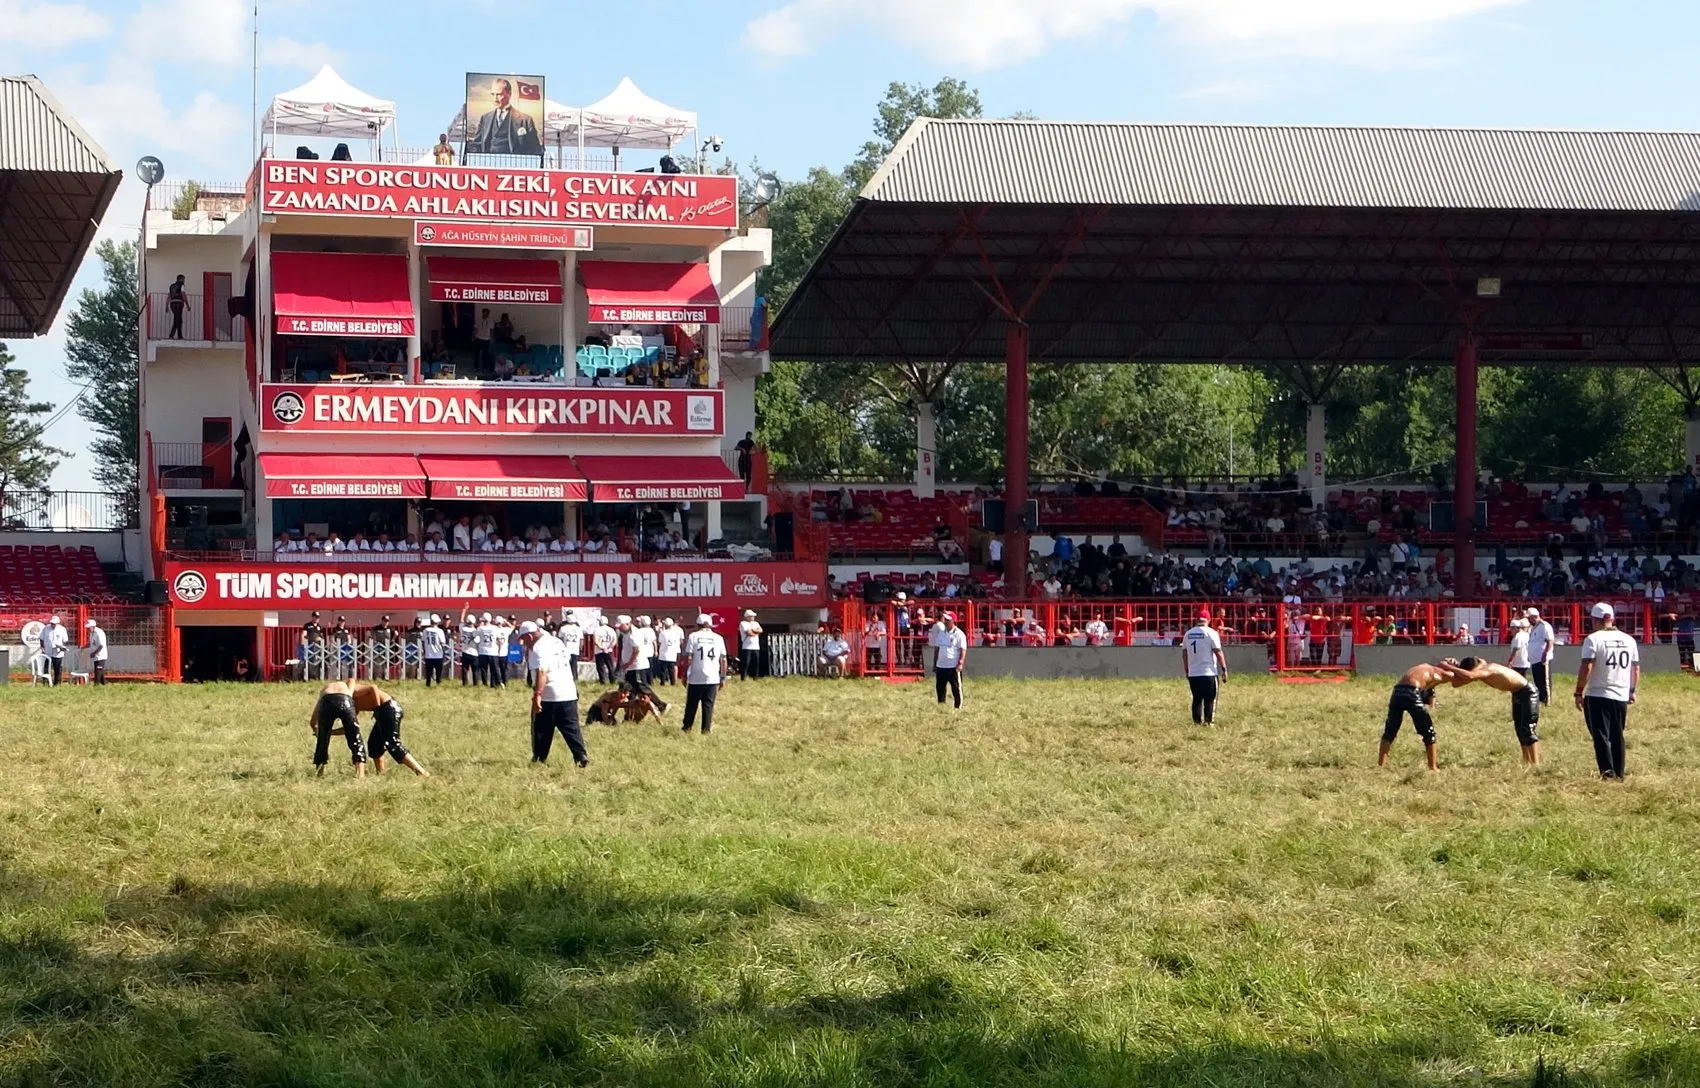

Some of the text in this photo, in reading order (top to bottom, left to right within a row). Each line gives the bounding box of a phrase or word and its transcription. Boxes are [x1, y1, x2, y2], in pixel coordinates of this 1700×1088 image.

[269, 165, 697, 199] BEN SPORCUNUN ZEKİ, ÇEVİK AYNI
[268, 190, 398, 212] ZAMANDA
[404, 195, 558, 218] AHLAKLISINI
[565, 199, 675, 221] SEVERİM.
[441, 230, 460, 240] AĞA
[461, 230, 499, 241] HÜSEYİN
[530, 232, 568, 244] TRİBÜNÜ
[444, 287, 549, 302] T.C. EDİRNE BELEDİYESİ
[603, 308, 707, 322] T.C. EDİRNE BELEDİYESİ
[292, 318, 402, 334] T.C. EDİRNE BELEDİYESİ
[314, 394, 674, 426] ERMEYDANI KIRKPINAR
[1315, 452, 1322, 463] B
[291, 482, 402, 496] T.C. EDİRNE BELEDİYESİ
[456, 483, 564, 498] T.C. EDİRNE BELEDİYESİ
[616, 485, 723, 500] T.C. EDİRNE BELEDİYESİ
[215, 572, 272, 599] TÜM
[276, 572, 490, 599] SPORCULARIMIZA
[493, 572, 622, 600] BAŞARILAR
[697, 646, 716, 661] 14
[1190, 640, 1197, 654] 1
[1605, 650, 1630, 670] 40
